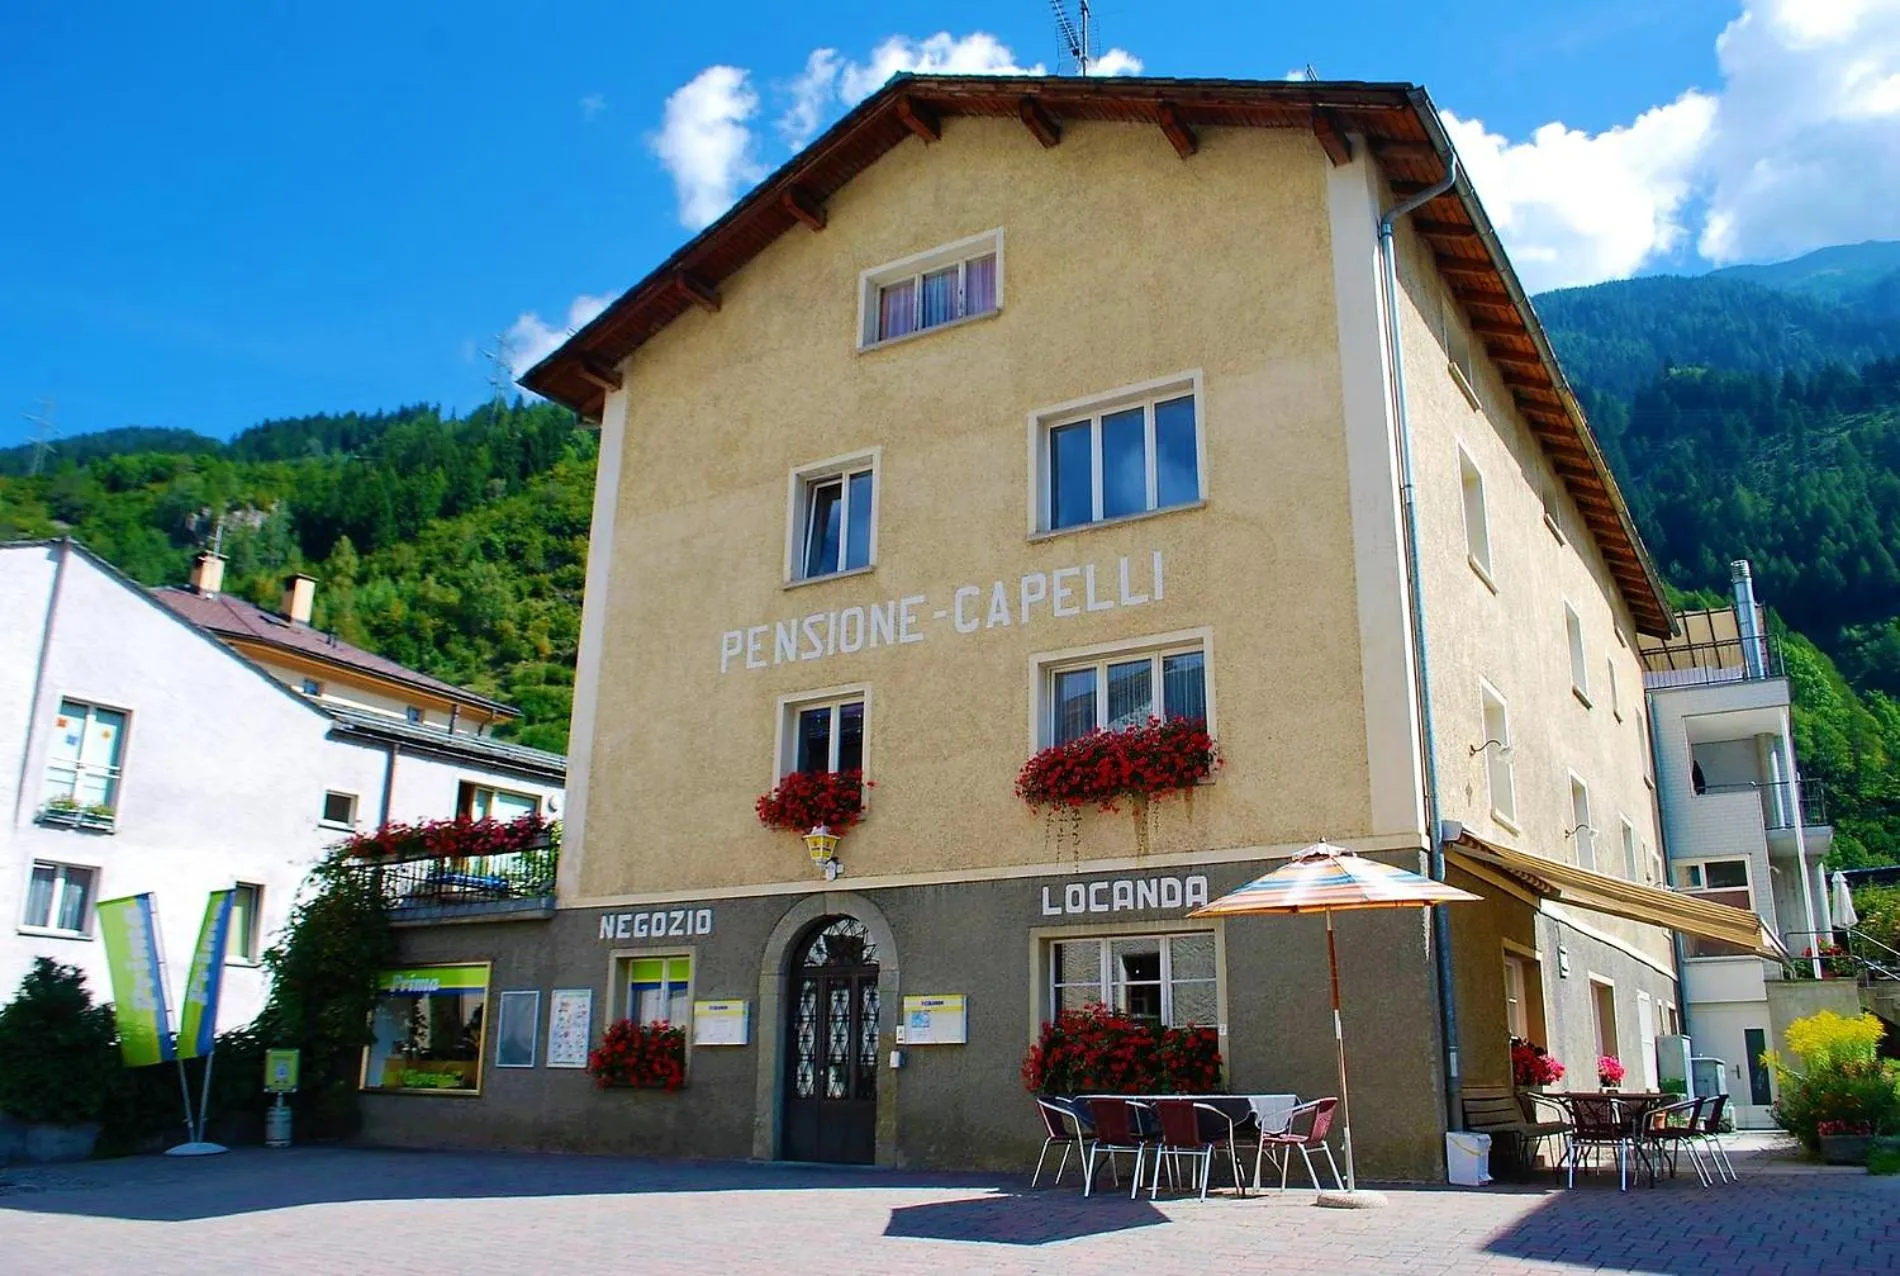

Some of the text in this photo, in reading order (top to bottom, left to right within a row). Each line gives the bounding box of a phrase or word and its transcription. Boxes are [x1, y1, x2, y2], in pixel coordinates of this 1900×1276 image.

[1042, 875, 1208, 916] LOCANDA
[599, 908, 714, 940] NEGOZIO
[389, 974, 440, 992] Prima
